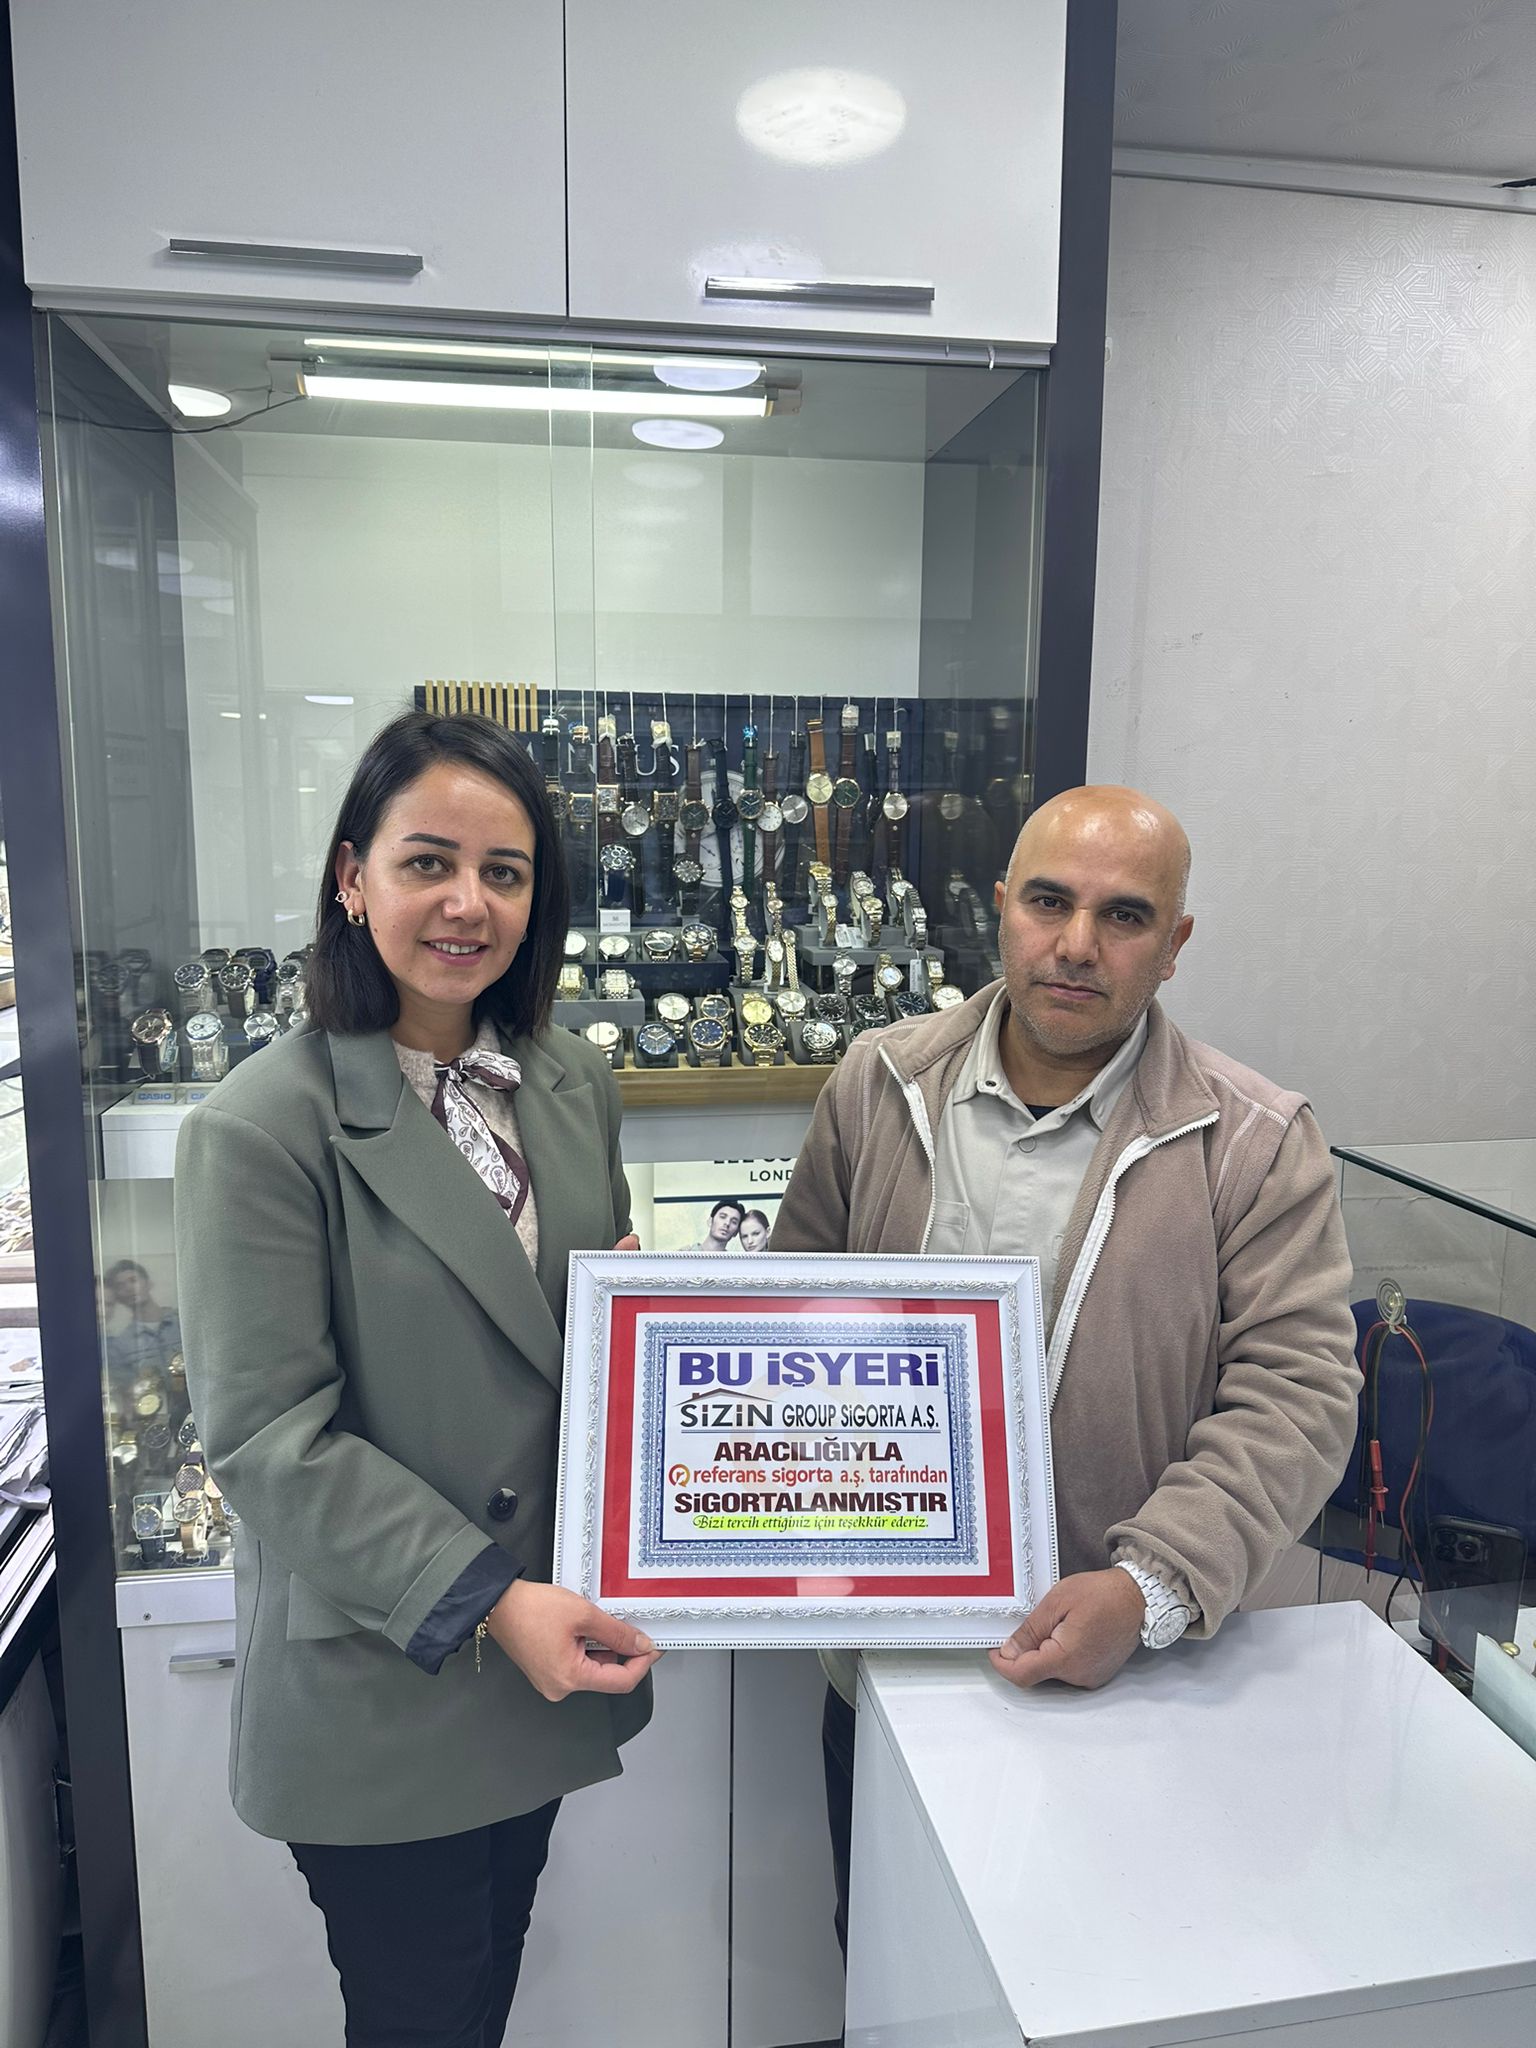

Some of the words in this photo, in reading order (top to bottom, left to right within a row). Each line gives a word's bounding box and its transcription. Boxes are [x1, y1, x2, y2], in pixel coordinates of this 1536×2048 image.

[679, 1352, 753, 1386] BU
[782, 1404, 835, 1428] GROUP
[911, 1405, 939, 1430] A.Ş.
[713, 1436, 903, 1462] ARACILIĞIYLA
[694, 1465, 766, 1483] referans
[772, 1467, 832, 1487] sigorta
[869, 1465, 948, 1484] tarafından
[692, 1515, 724, 1529] Bizi
[727, 1516, 759, 1529] tercih
[814, 1517, 835, 1531] için
[838, 1516, 887, 1530] teşekkür
[891, 1516, 929, 1529] ederiz.
